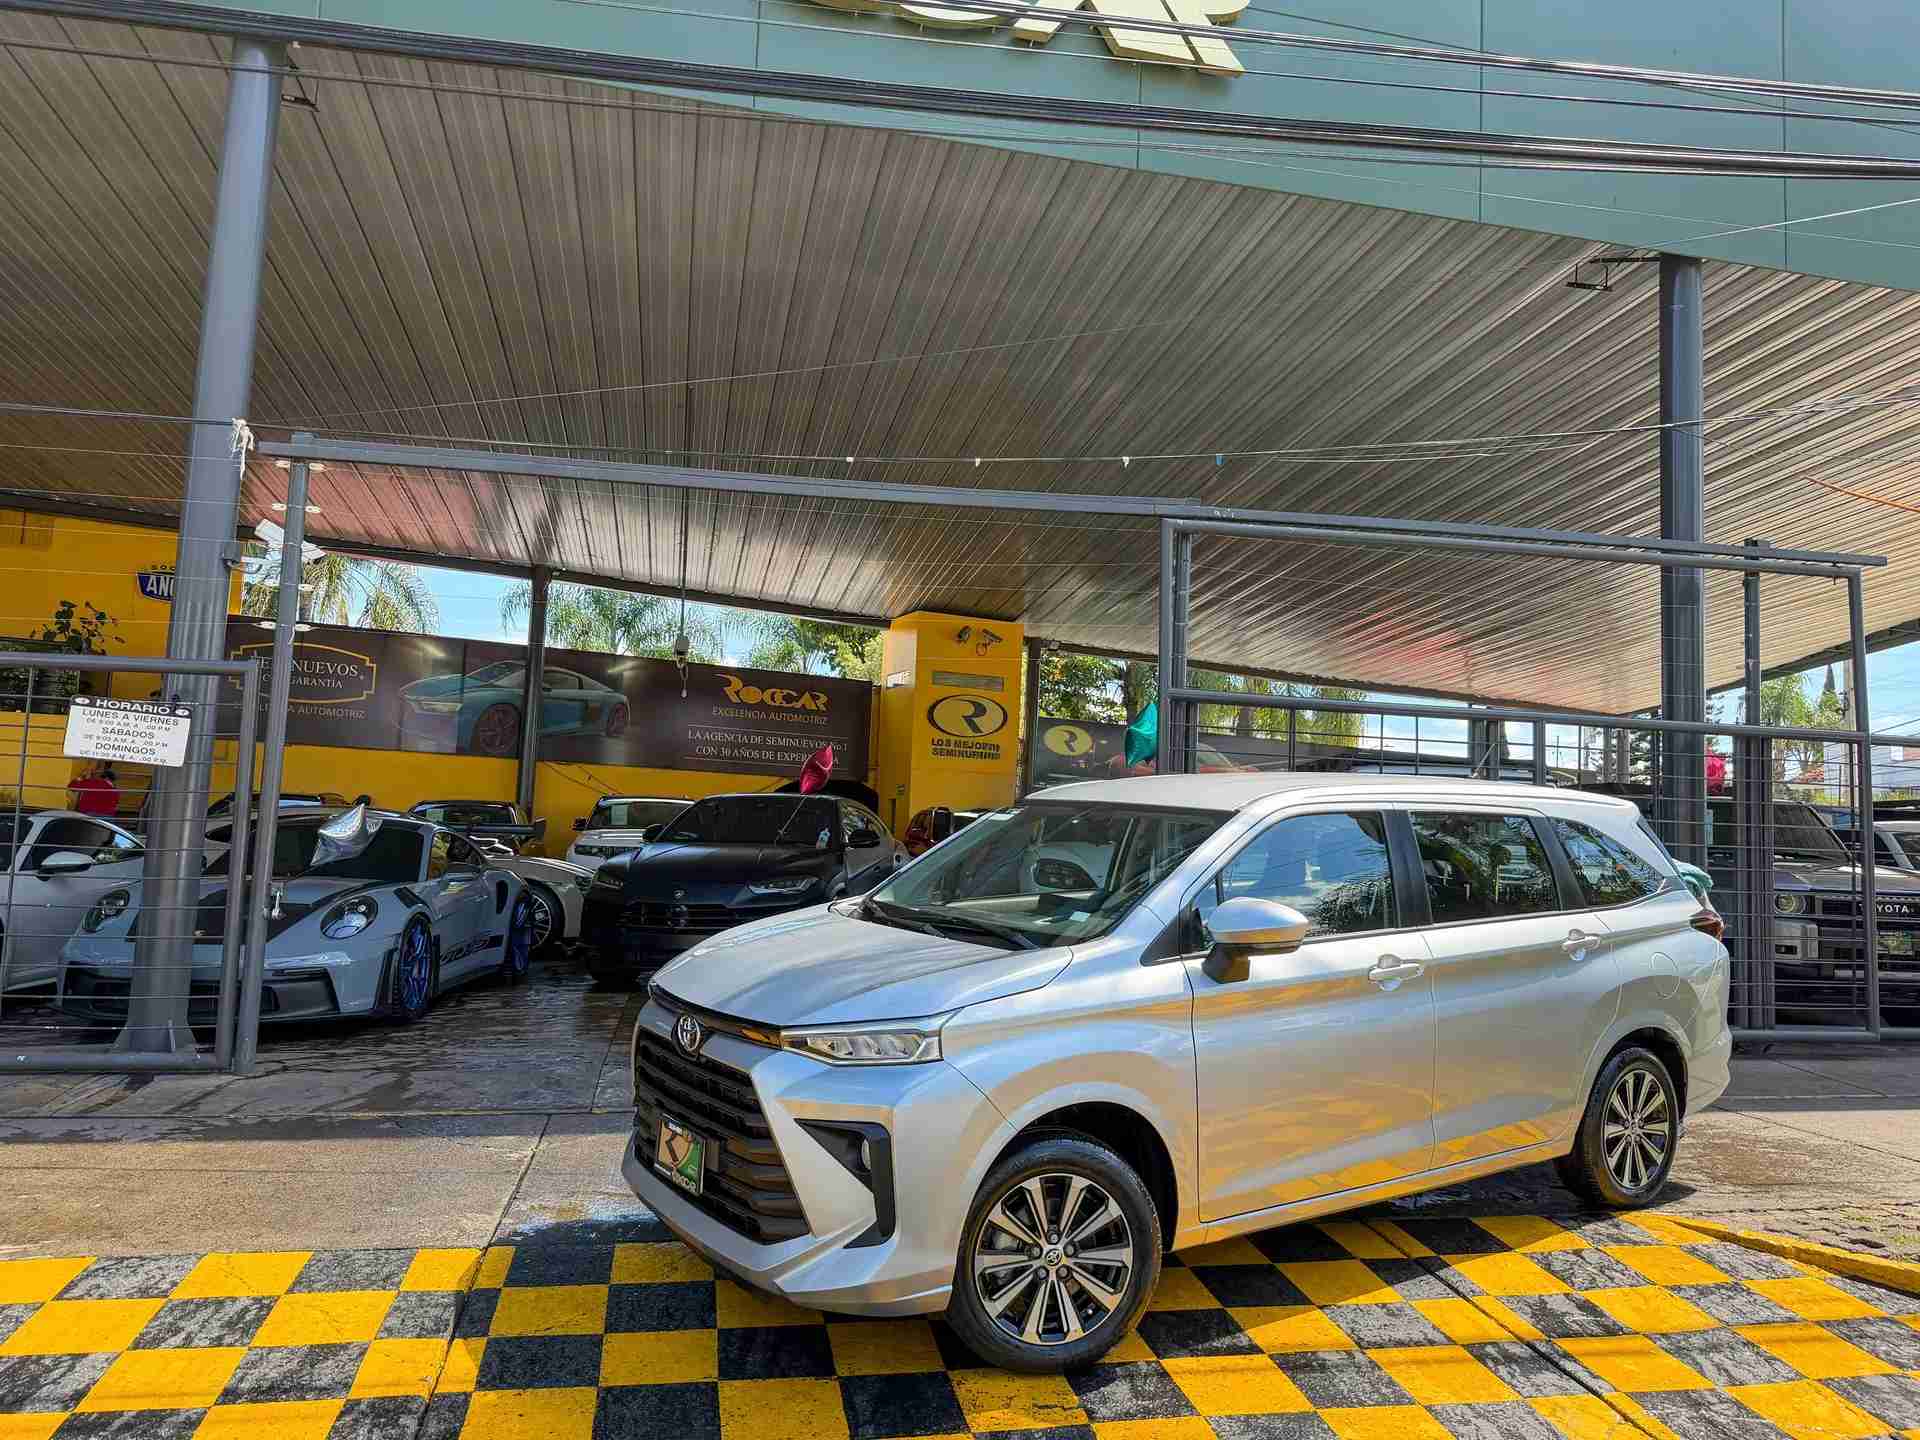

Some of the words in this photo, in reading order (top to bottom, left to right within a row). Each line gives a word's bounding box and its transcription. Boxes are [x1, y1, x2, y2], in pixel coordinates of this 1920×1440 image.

[96, 699, 170, 715] HORARIO
[82, 708, 119, 720] LUNES
[133, 714, 179, 726] VIERNES
[95, 742, 156, 755] DOMINGOS
[762, 750, 776, 760] DE
[1858, 903, 1909, 912] TYOTA
